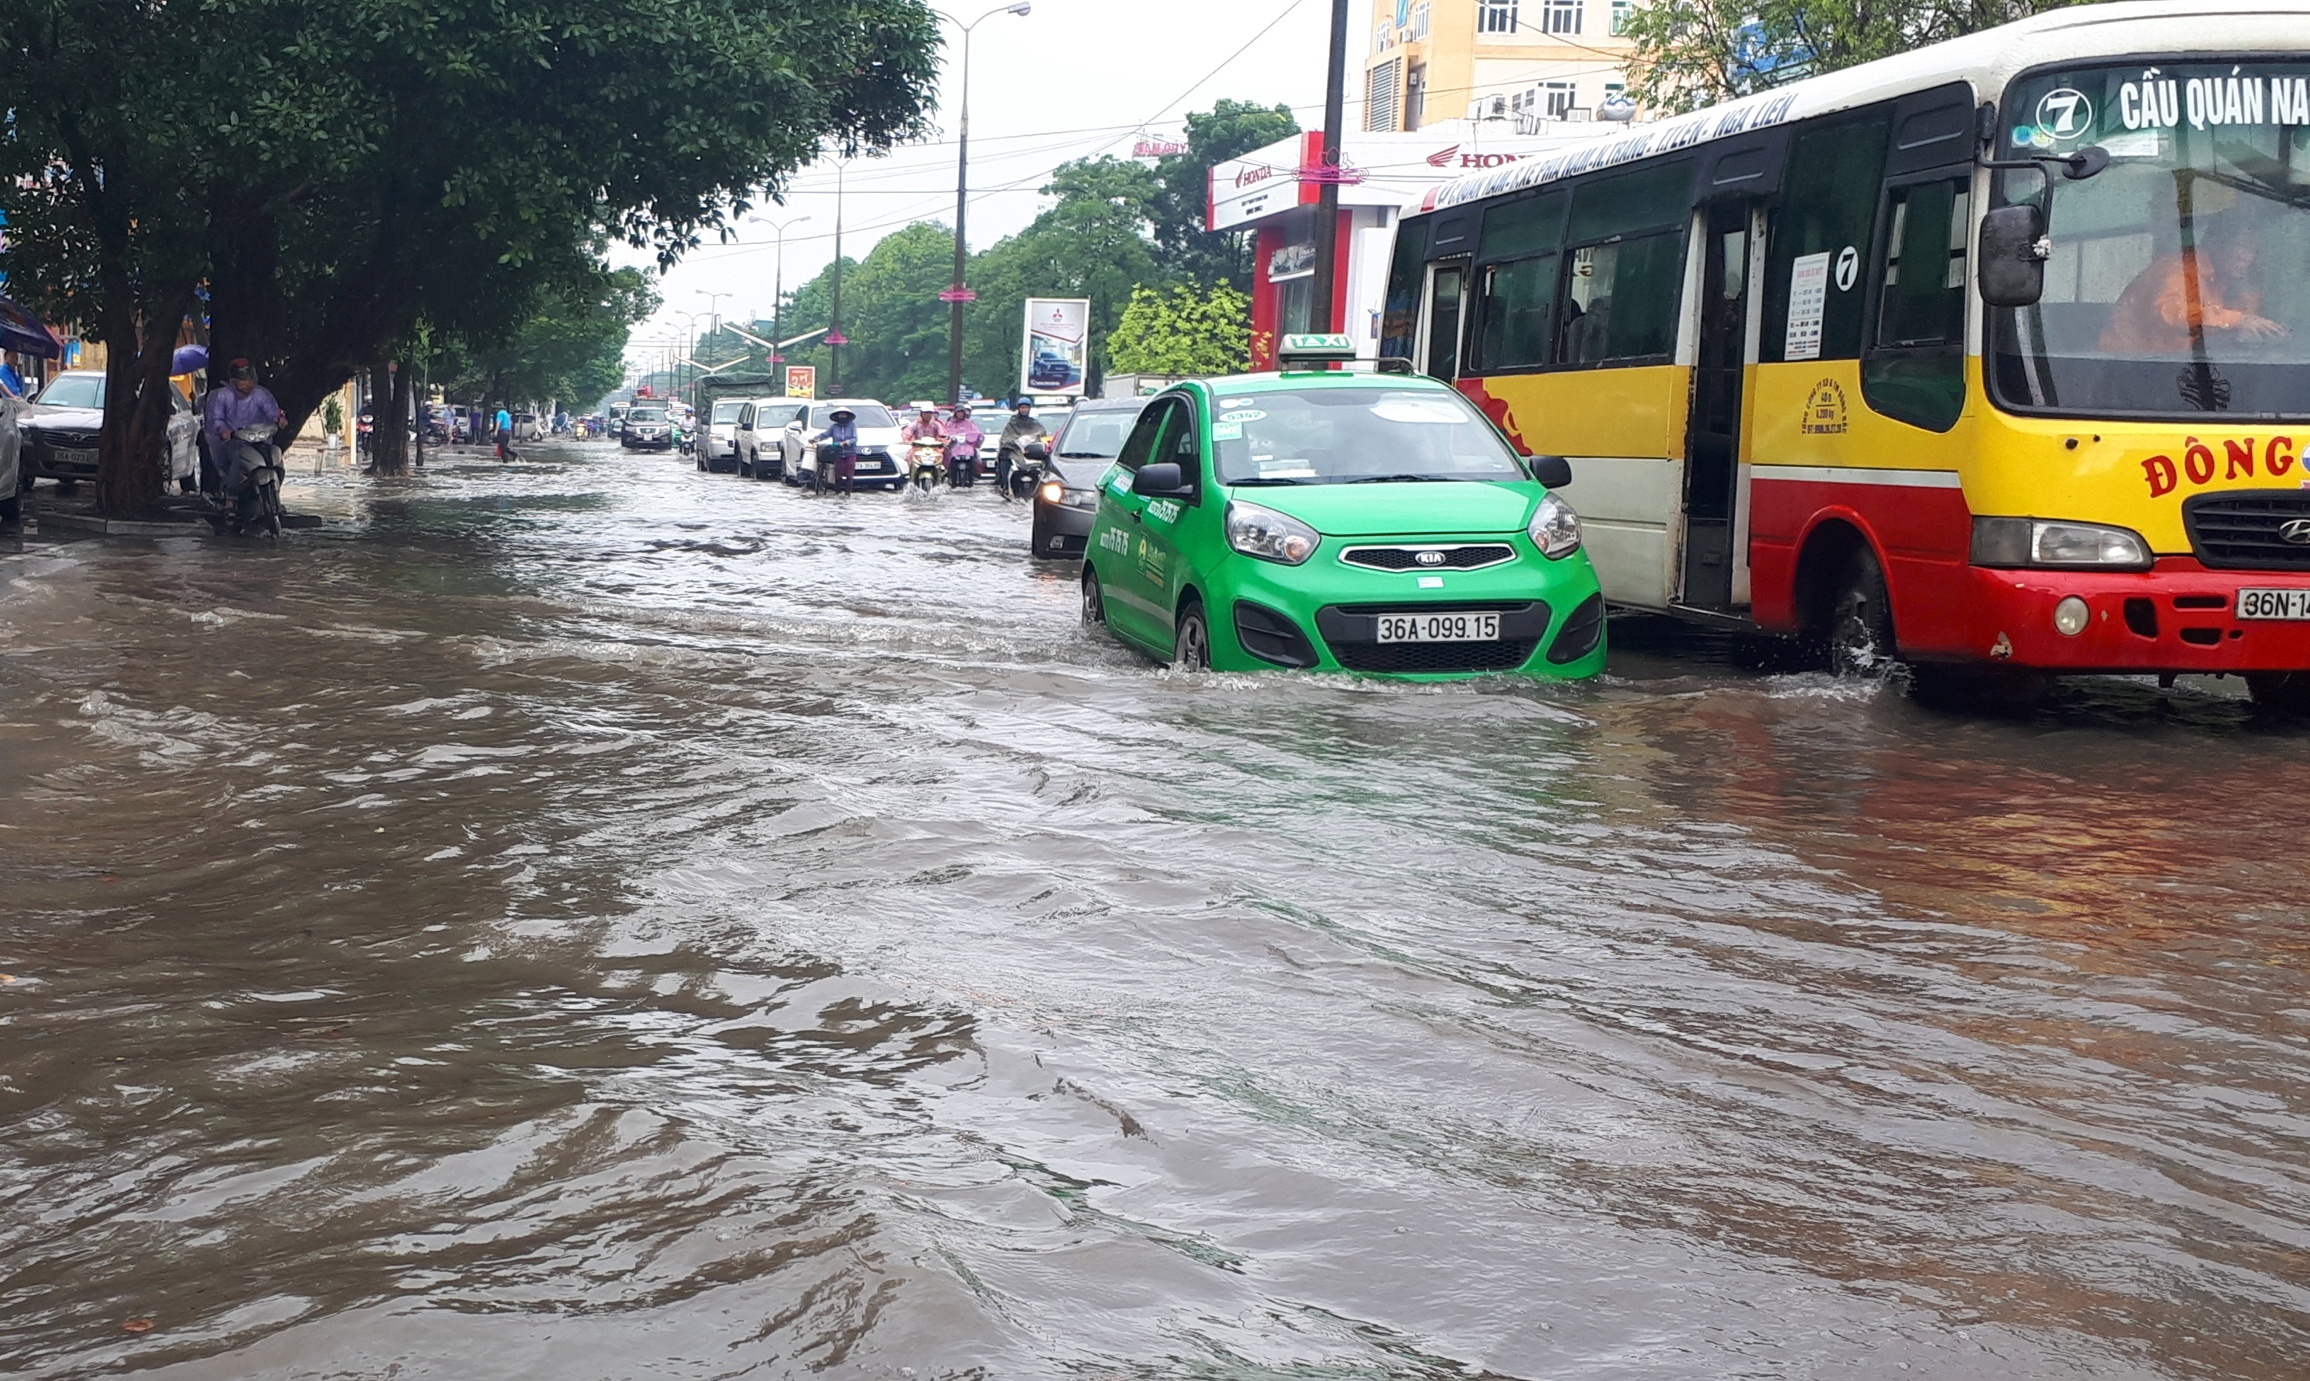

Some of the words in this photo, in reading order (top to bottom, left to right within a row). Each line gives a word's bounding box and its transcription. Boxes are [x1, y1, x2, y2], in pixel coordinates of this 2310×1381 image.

[2120, 66, 2179, 130] CẦU
[2186, 65, 2263, 131] QUÁN
[2271, 78, 2310, 125] NA
[2046, 95, 2079, 132] 7
[1243, 164, 1272, 187] HONDA
[1841, 253, 1855, 286] 7
[1290, 336, 1350, 347] TAXI
[2141, 436, 2294, 498] ĐÔNG
[1420, 553, 1442, 563] KIA
[2244, 592, 2310, 617] 36N-1
[1381, 616, 1497, 640] 36A-099.15
